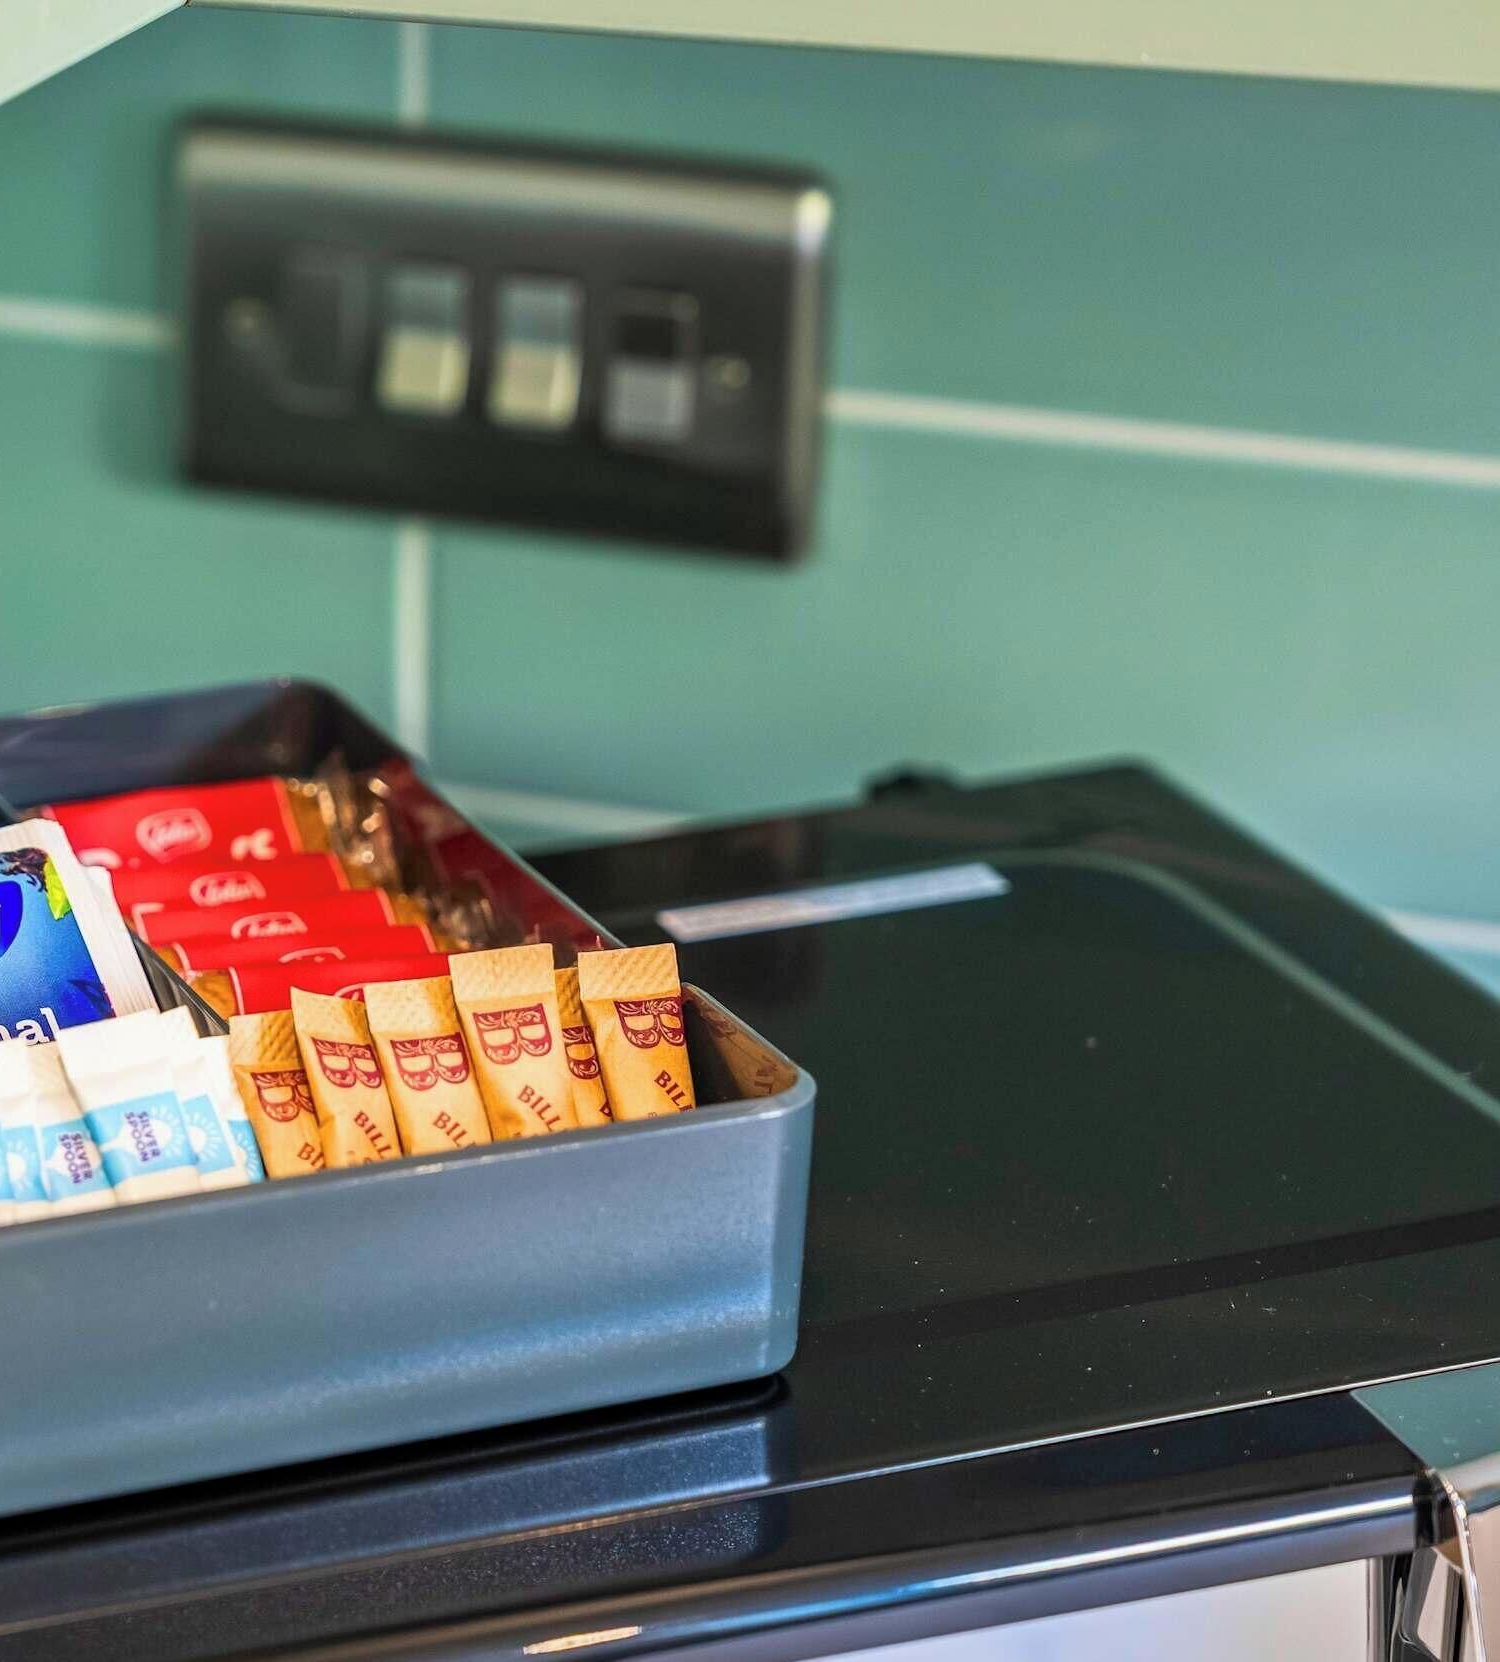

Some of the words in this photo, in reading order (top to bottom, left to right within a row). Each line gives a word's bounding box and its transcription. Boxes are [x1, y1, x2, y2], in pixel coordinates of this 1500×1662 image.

[124, 1111, 149, 1162] SPOON
[136, 1111, 161, 1157] SILVER
[433, 1110, 476, 1147] BIL
[59, 1134, 82, 1184] SPOON
[71, 1133, 93, 1180] SILVER
